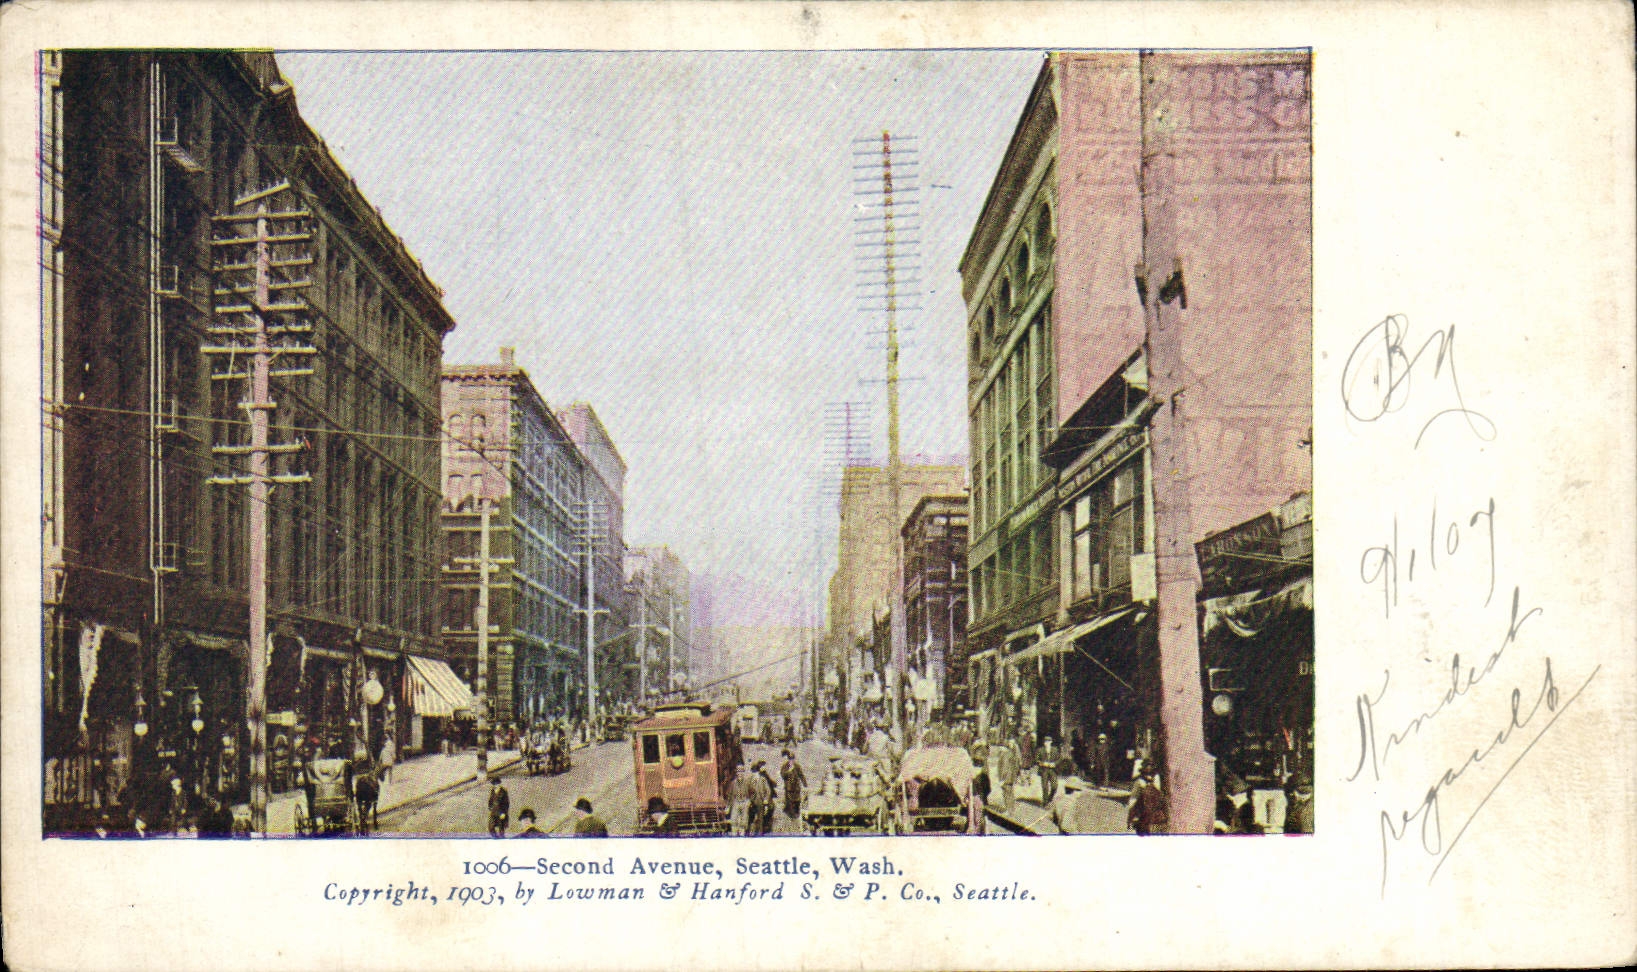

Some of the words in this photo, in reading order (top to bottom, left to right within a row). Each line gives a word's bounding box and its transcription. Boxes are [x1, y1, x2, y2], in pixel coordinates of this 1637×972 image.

[1346, 586, 1544, 782] Kindest
[629, 857, 723, 879] Avenue,
[736, 856, 820, 879] Seattle,
[829, 856, 903, 876] Wash.
[323, 880, 438, 906] Copyright,
[446, 886, 505, 906] 1903,
[515, 881, 535, 906] by
[547, 882, 645, 900] Lowman
[659, 882, 681, 900] &
[691, 881, 784, 906] Hanford
[800, 882, 819, 900] S.
[832, 882, 855, 900] &
[864, 882, 887, 901] P.
[900, 882, 941, 904] Co.,
[953, 882, 1036, 901] Seattle.
